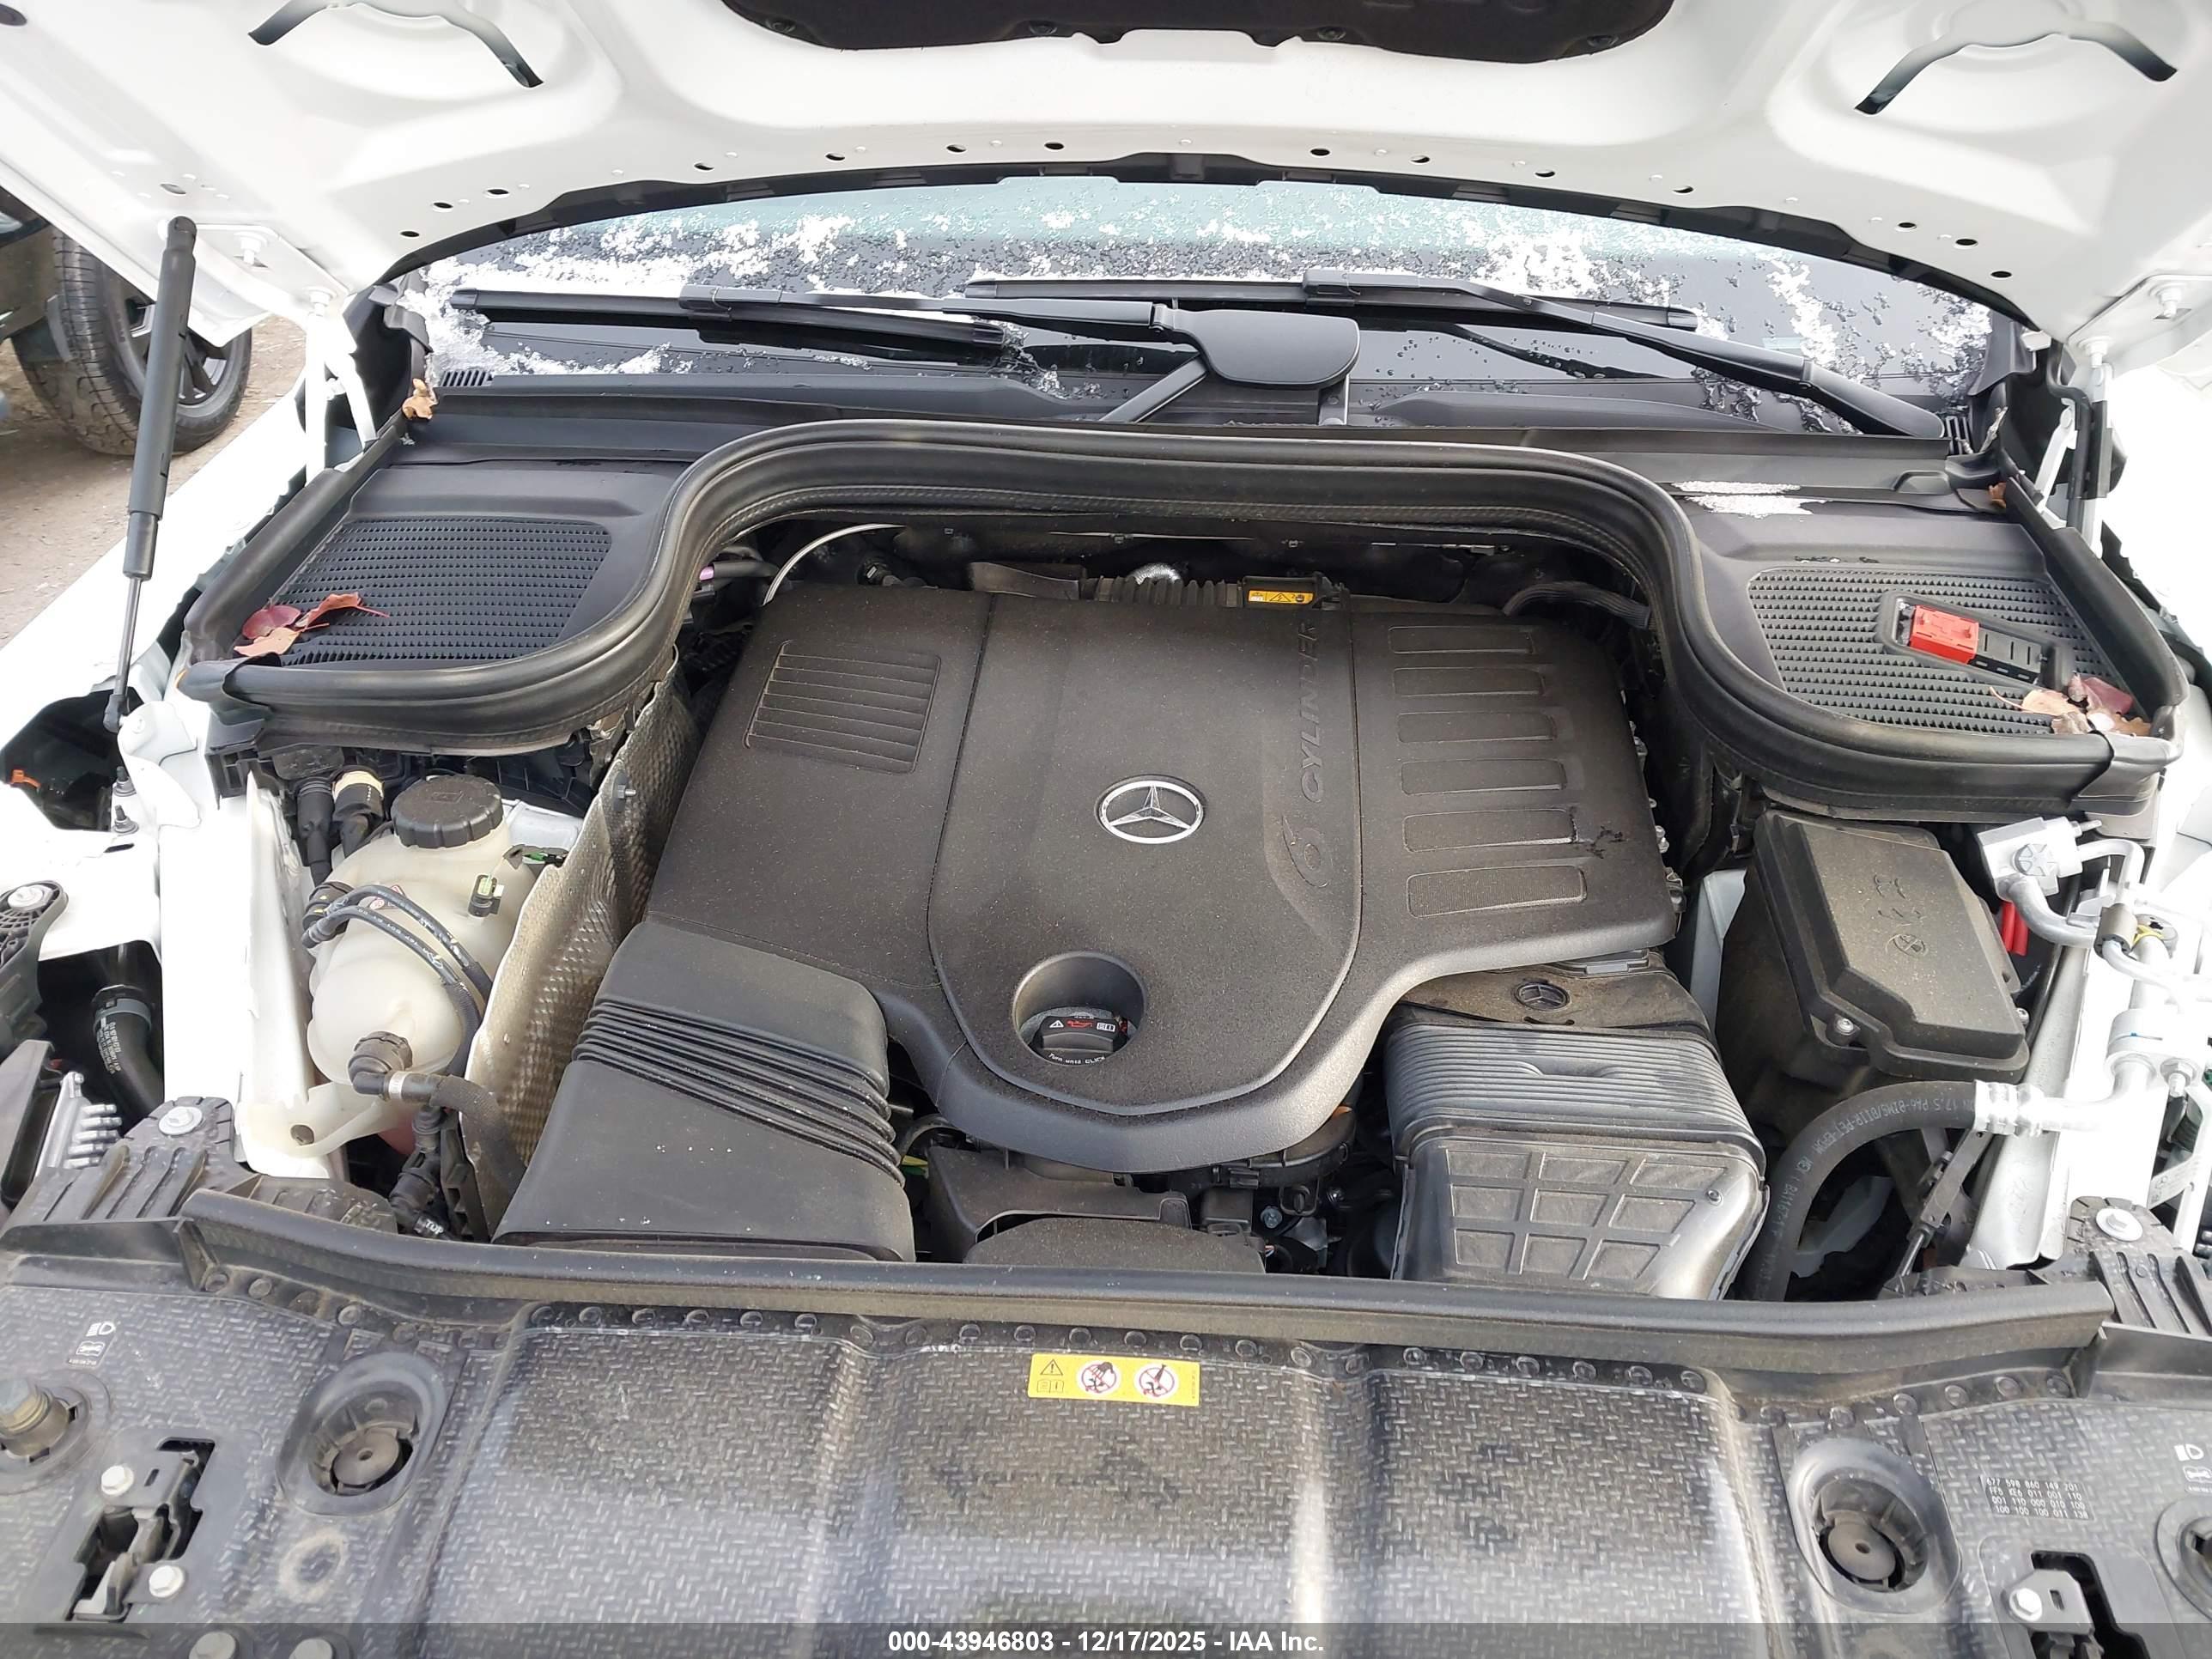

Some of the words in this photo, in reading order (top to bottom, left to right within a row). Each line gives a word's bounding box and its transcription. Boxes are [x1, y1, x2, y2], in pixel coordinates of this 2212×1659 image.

[1298, 623, 1321, 805] CYLINDER
[425, 1218, 444, 1235] TOP
[1992, 1496, 2007, 1504] 001
[2047, 1491, 2062, 1499] 001
